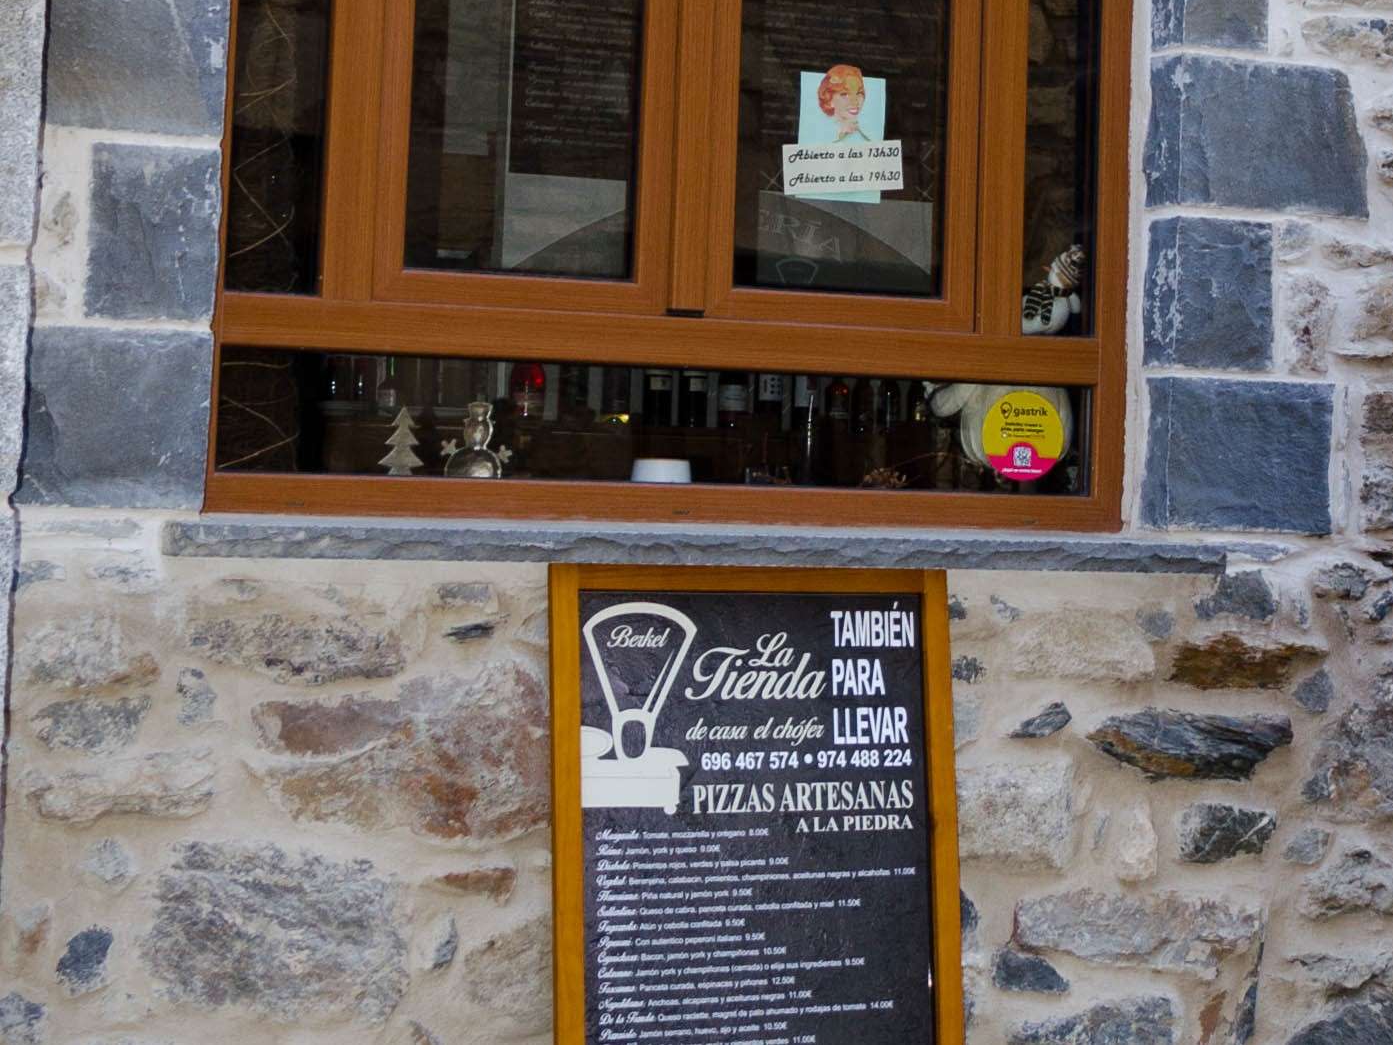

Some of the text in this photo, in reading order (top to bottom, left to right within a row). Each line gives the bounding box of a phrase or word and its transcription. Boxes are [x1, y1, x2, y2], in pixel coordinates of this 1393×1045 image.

[788, 149, 835, 163] Abierto
[848, 149, 863, 158] las
[868, 146, 900, 158] 13h30
[789, 170, 901, 187] Abierto a las 19h30
[830, 601, 915, 648] TAMBIÉN
[606, 624, 670, 649] Berkel
[748, 631, 795, 668] La
[685, 646, 828, 701] Tienda
[831, 658, 886, 696] PARA
[685, 716, 825, 748] de casa el chófer
[833, 706, 909, 745] LLEVAR
[702, 748, 912, 771] 696 467 574 974 488 224
[692, 779, 914, 815] PIZZAS ARTESANAS
[796, 814, 914, 834] A LA PIEDRA
[675, 846, 697, 855] queso
[894, 867, 915, 875] 11.00€
[659, 891, 683, 899] natural
[714, 889, 729, 899] york
[664, 905, 674, 914] de
[838, 898, 861, 907] 11.50€
[745, 932, 765, 941] 9.50€
[763, 946, 786, 955] 10.50€
[845, 957, 865, 966] 9.50€
[738, 1008, 747, 1017] de
[832, 1003, 841, 1011] de
